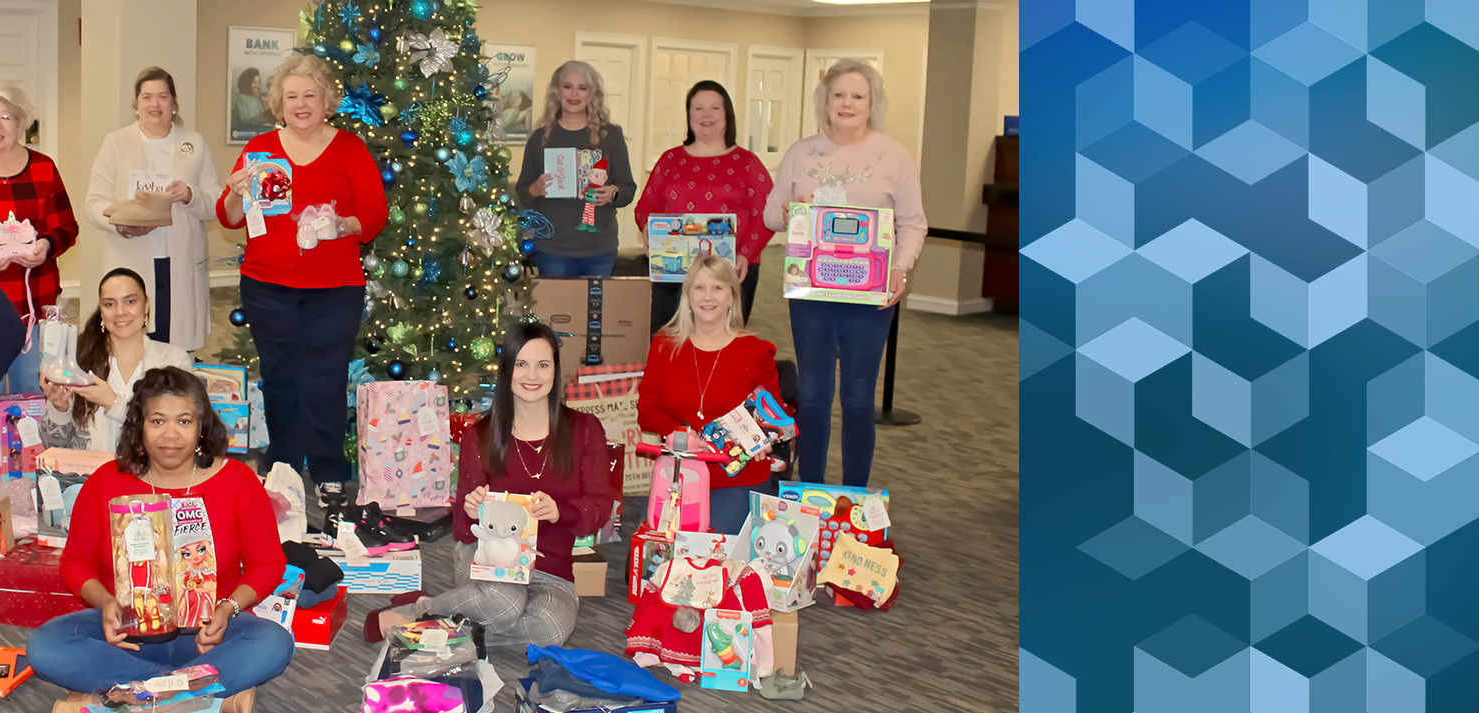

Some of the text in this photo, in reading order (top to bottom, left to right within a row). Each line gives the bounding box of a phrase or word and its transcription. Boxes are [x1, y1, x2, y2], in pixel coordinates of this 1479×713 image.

[246, 38, 280, 50] BANK
[497, 52, 526, 61] GROW
[557, 154, 565, 166] Cat
[554, 174, 566, 190] Jack
[176, 509, 203, 521] OMG
